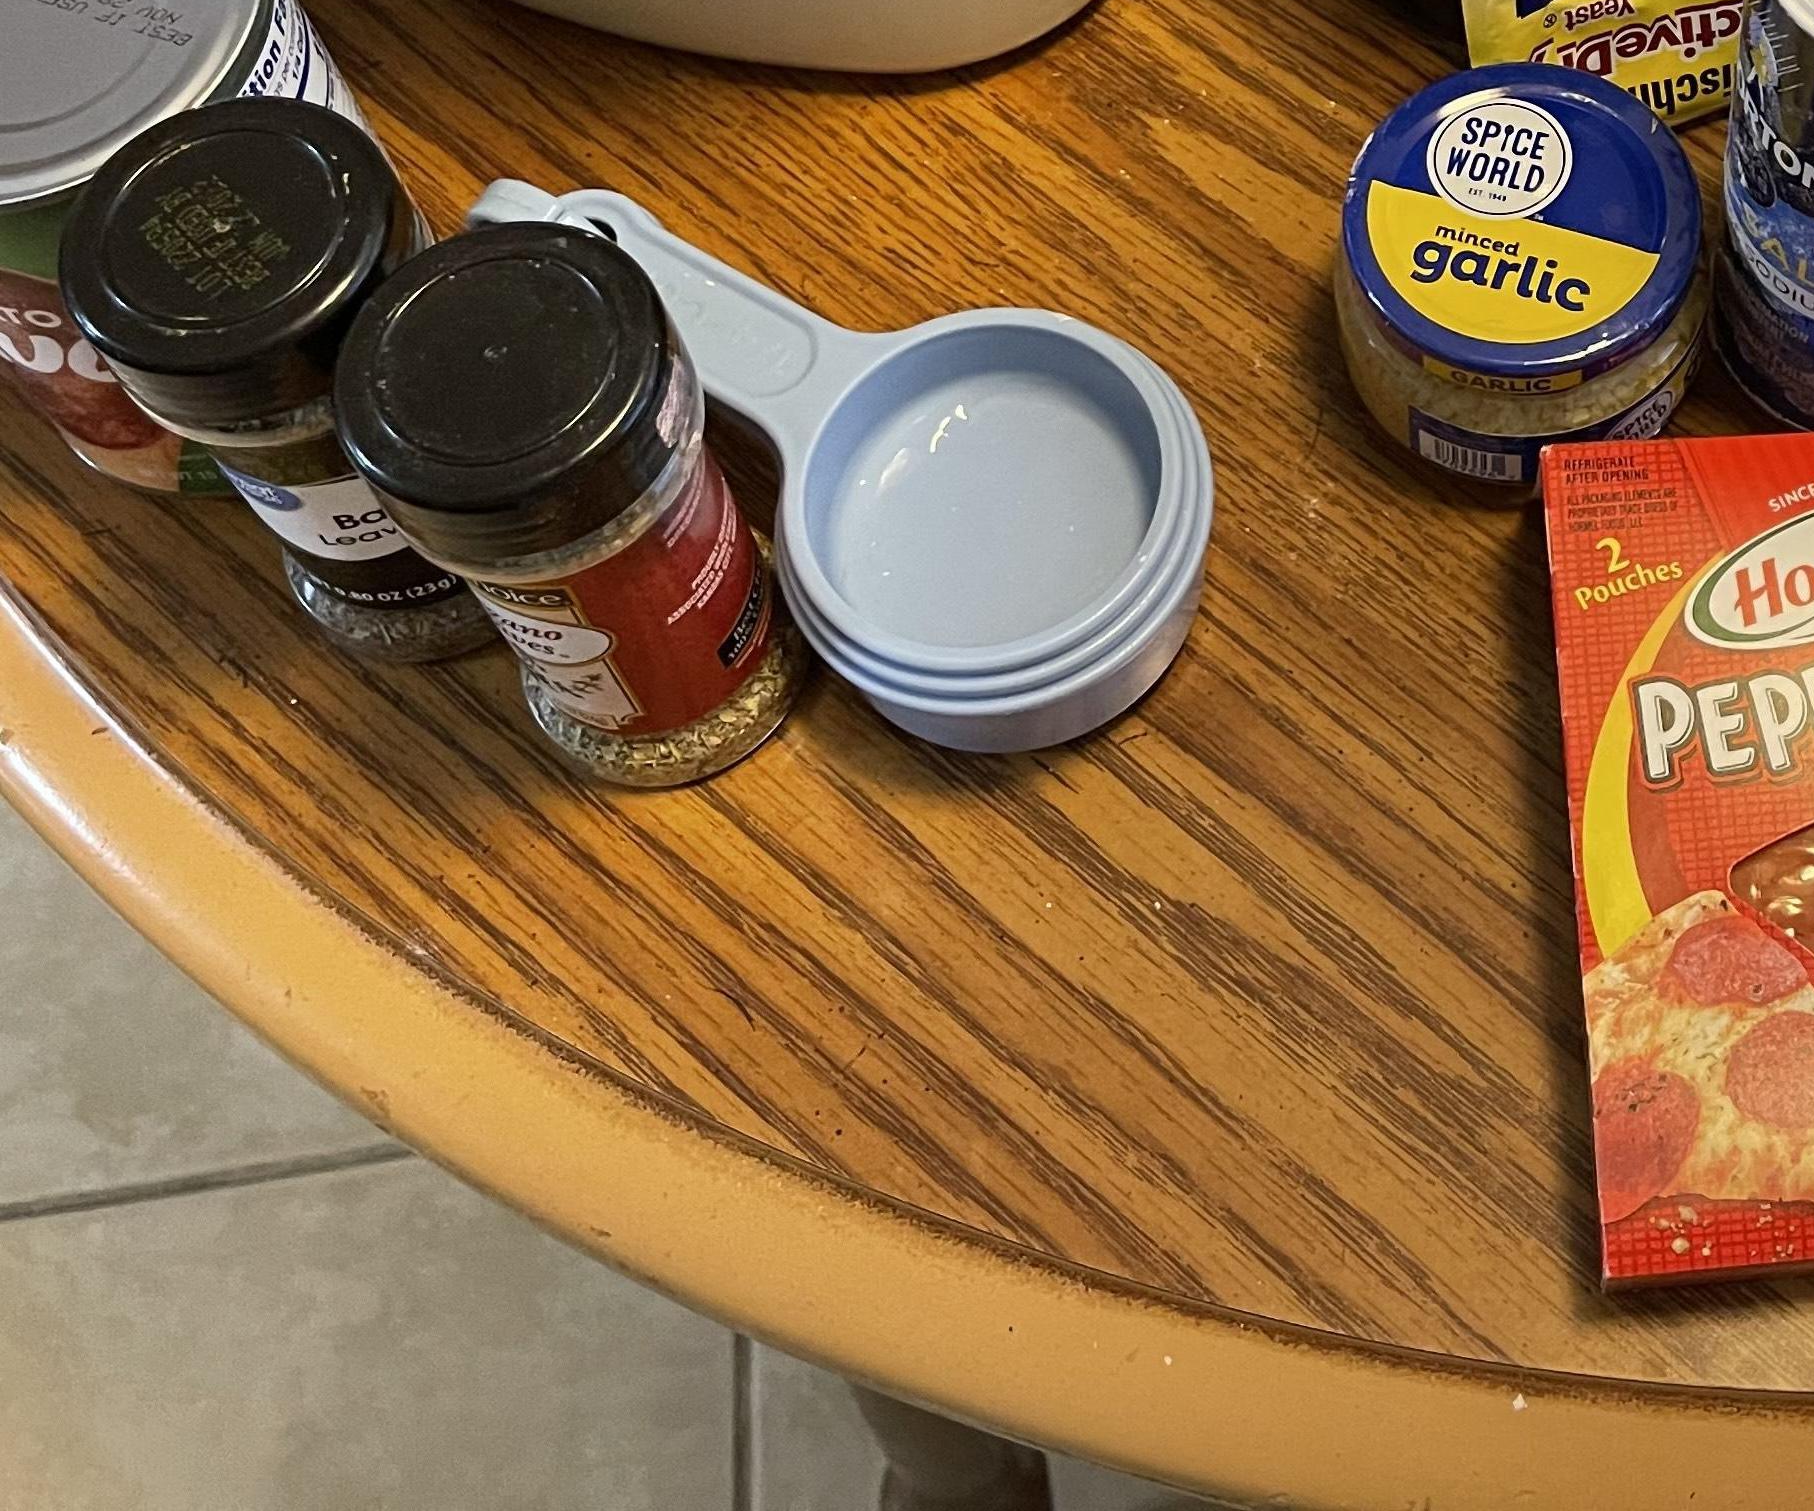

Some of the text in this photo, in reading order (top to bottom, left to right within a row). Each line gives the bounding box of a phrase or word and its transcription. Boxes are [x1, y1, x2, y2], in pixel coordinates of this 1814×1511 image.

[94, 11, 127, 26] IF
[136, 5, 183, 25] NOV
[133, 22, 193, 47] BEST
[1461, 117, 1550, 161] SPICE
[1446, 146, 1546, 193] WORLD
[1435, 224, 1520, 257] minced
[1410, 239, 1592, 314] garlic
[1450, 368, 1553, 394] GARLIC
[1563, 455, 1635, 471] REFRIGERATE
[1565, 468, 1649, 486] AFTER OPENING
[332, 508, 389, 531] Ba
[318, 526, 398, 546] Leav
[1596, 536, 1632, 575] 2
[405, 573, 458, 599] (23g)
[1573, 558, 1685, 613] Pouches
